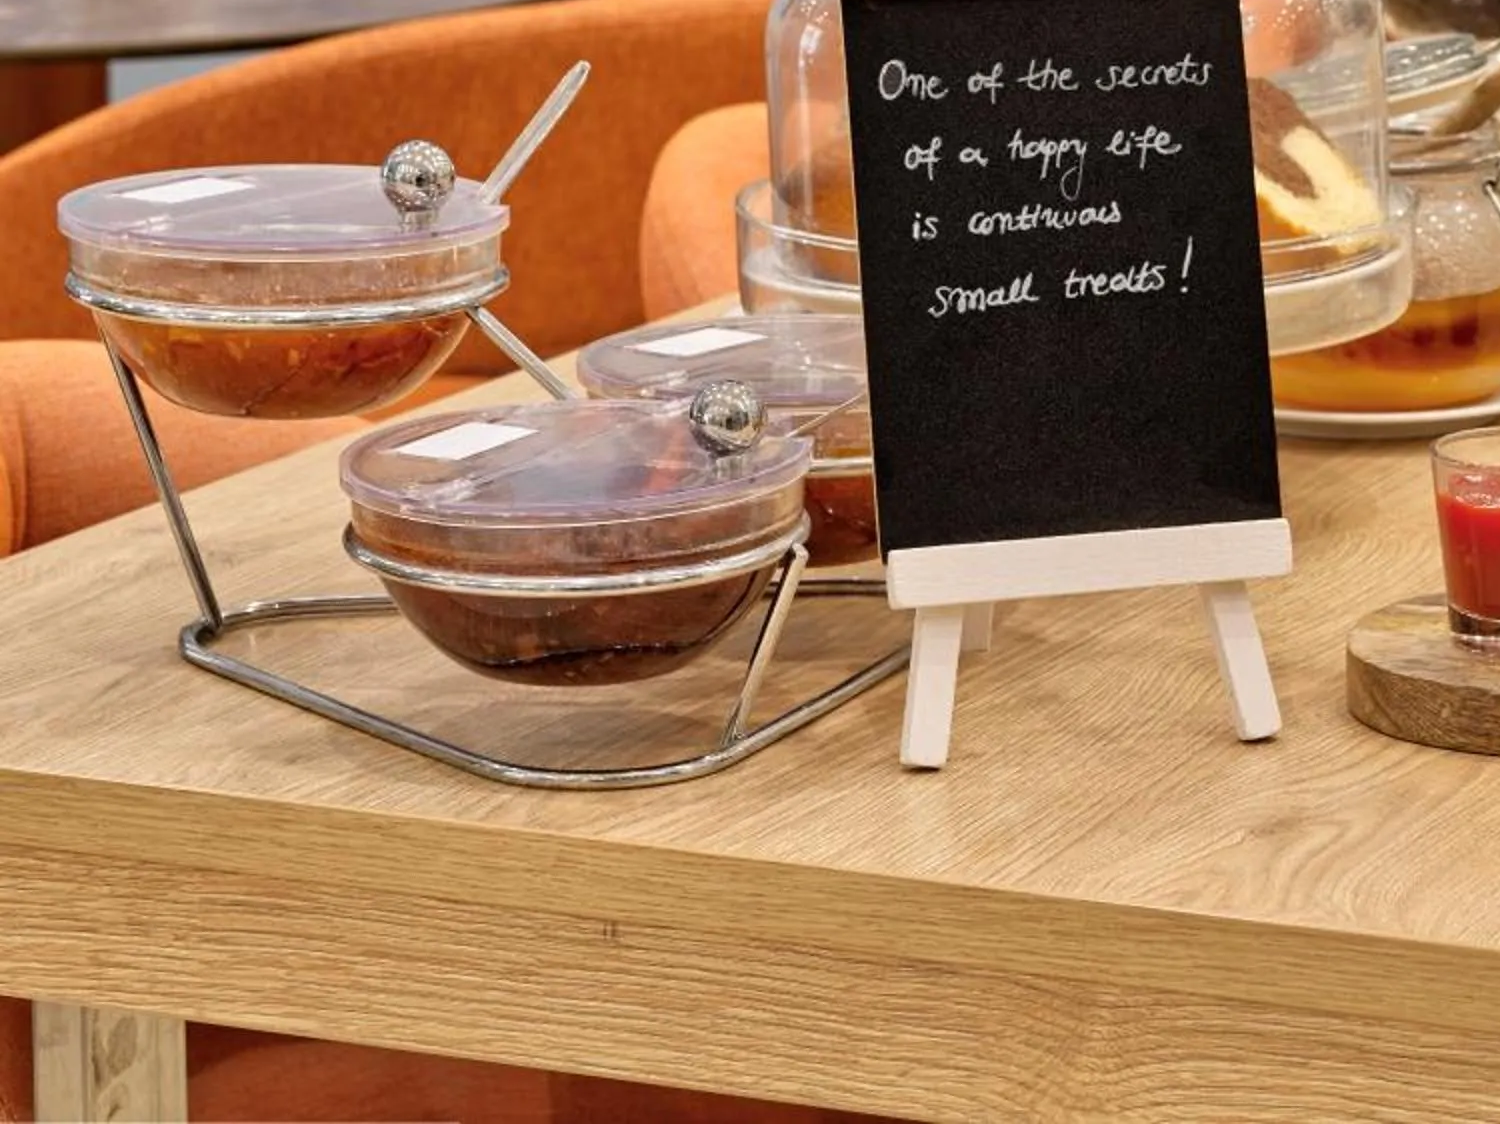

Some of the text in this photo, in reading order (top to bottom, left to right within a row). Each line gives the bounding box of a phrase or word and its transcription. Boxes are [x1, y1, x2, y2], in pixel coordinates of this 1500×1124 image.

[878, 52, 1213, 105] One of the secrets
[903, 125, 1183, 200] of a happy life
[911, 212, 940, 241] is
[927, 271, 1041, 318] small
